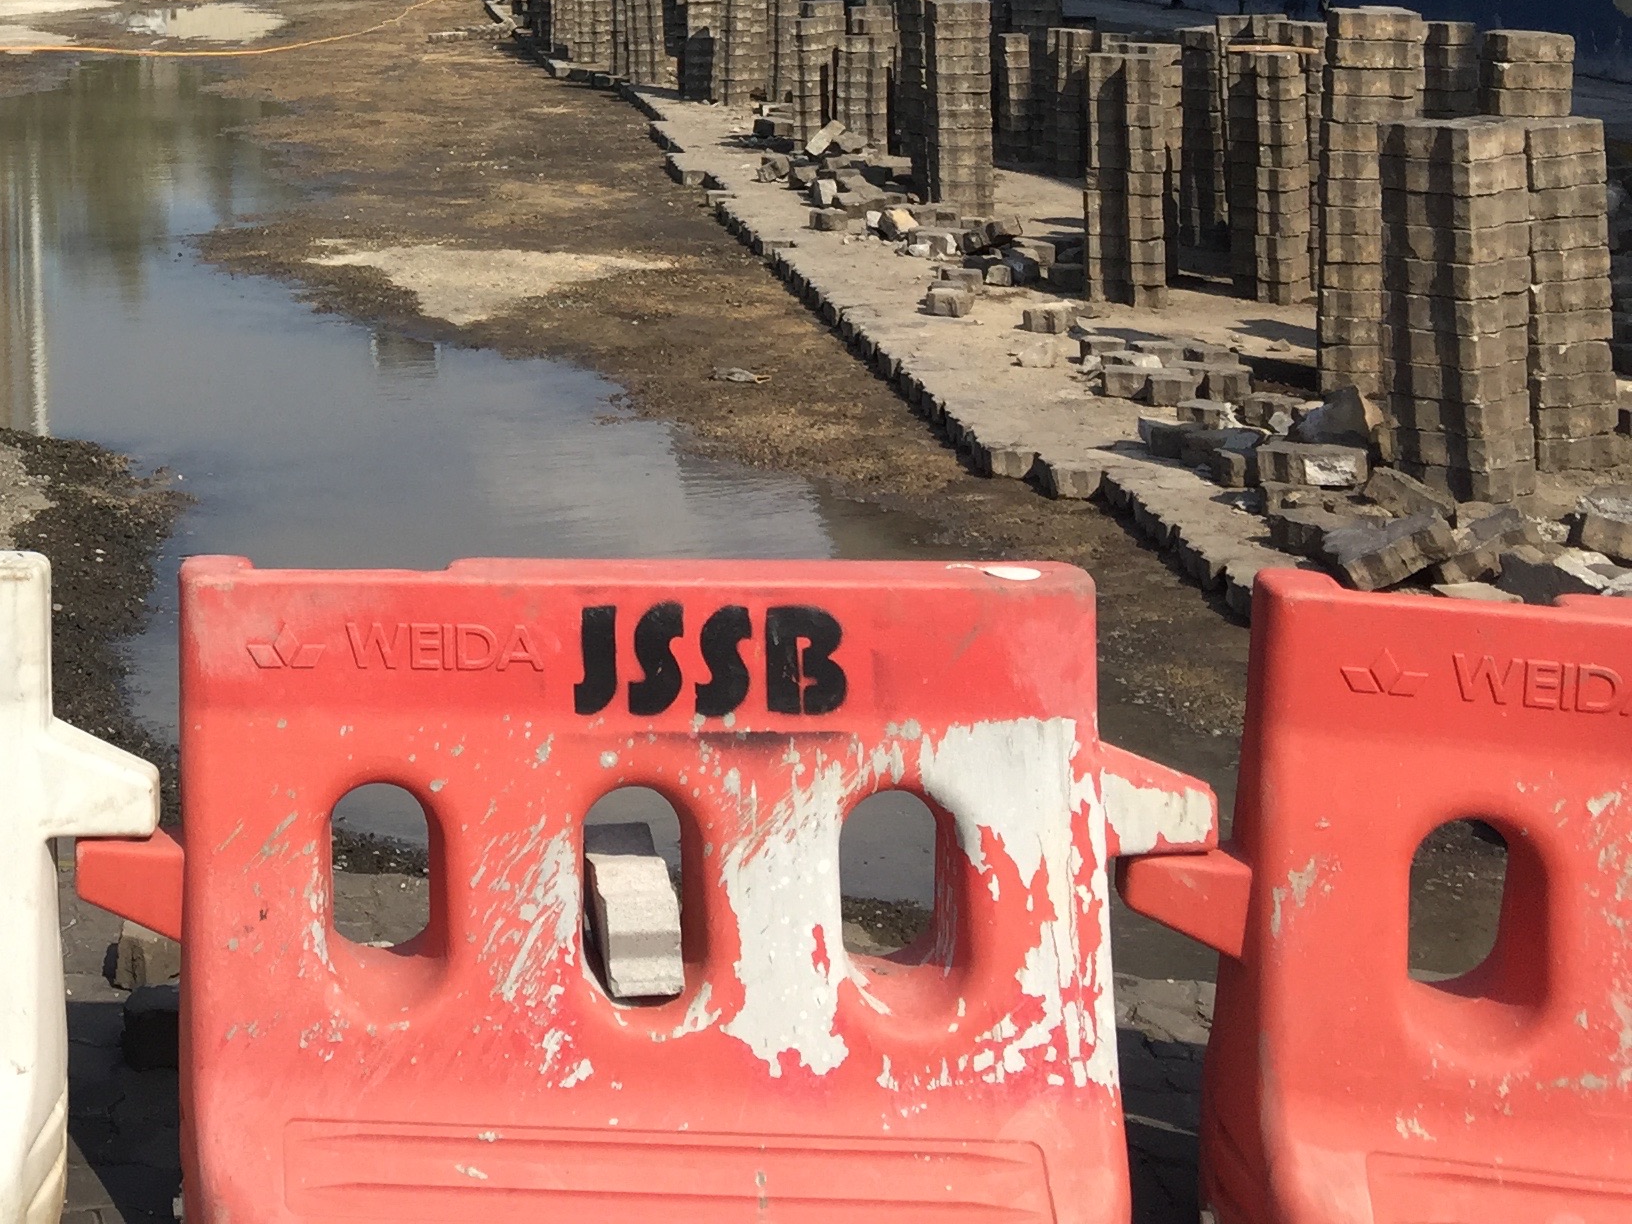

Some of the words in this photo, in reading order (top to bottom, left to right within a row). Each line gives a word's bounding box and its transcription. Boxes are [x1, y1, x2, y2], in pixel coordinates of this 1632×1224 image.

[344, 621, 545, 674] WEIDA
[573, 600, 849, 717] JSSB
[1452, 652, 1632, 717] WEID
